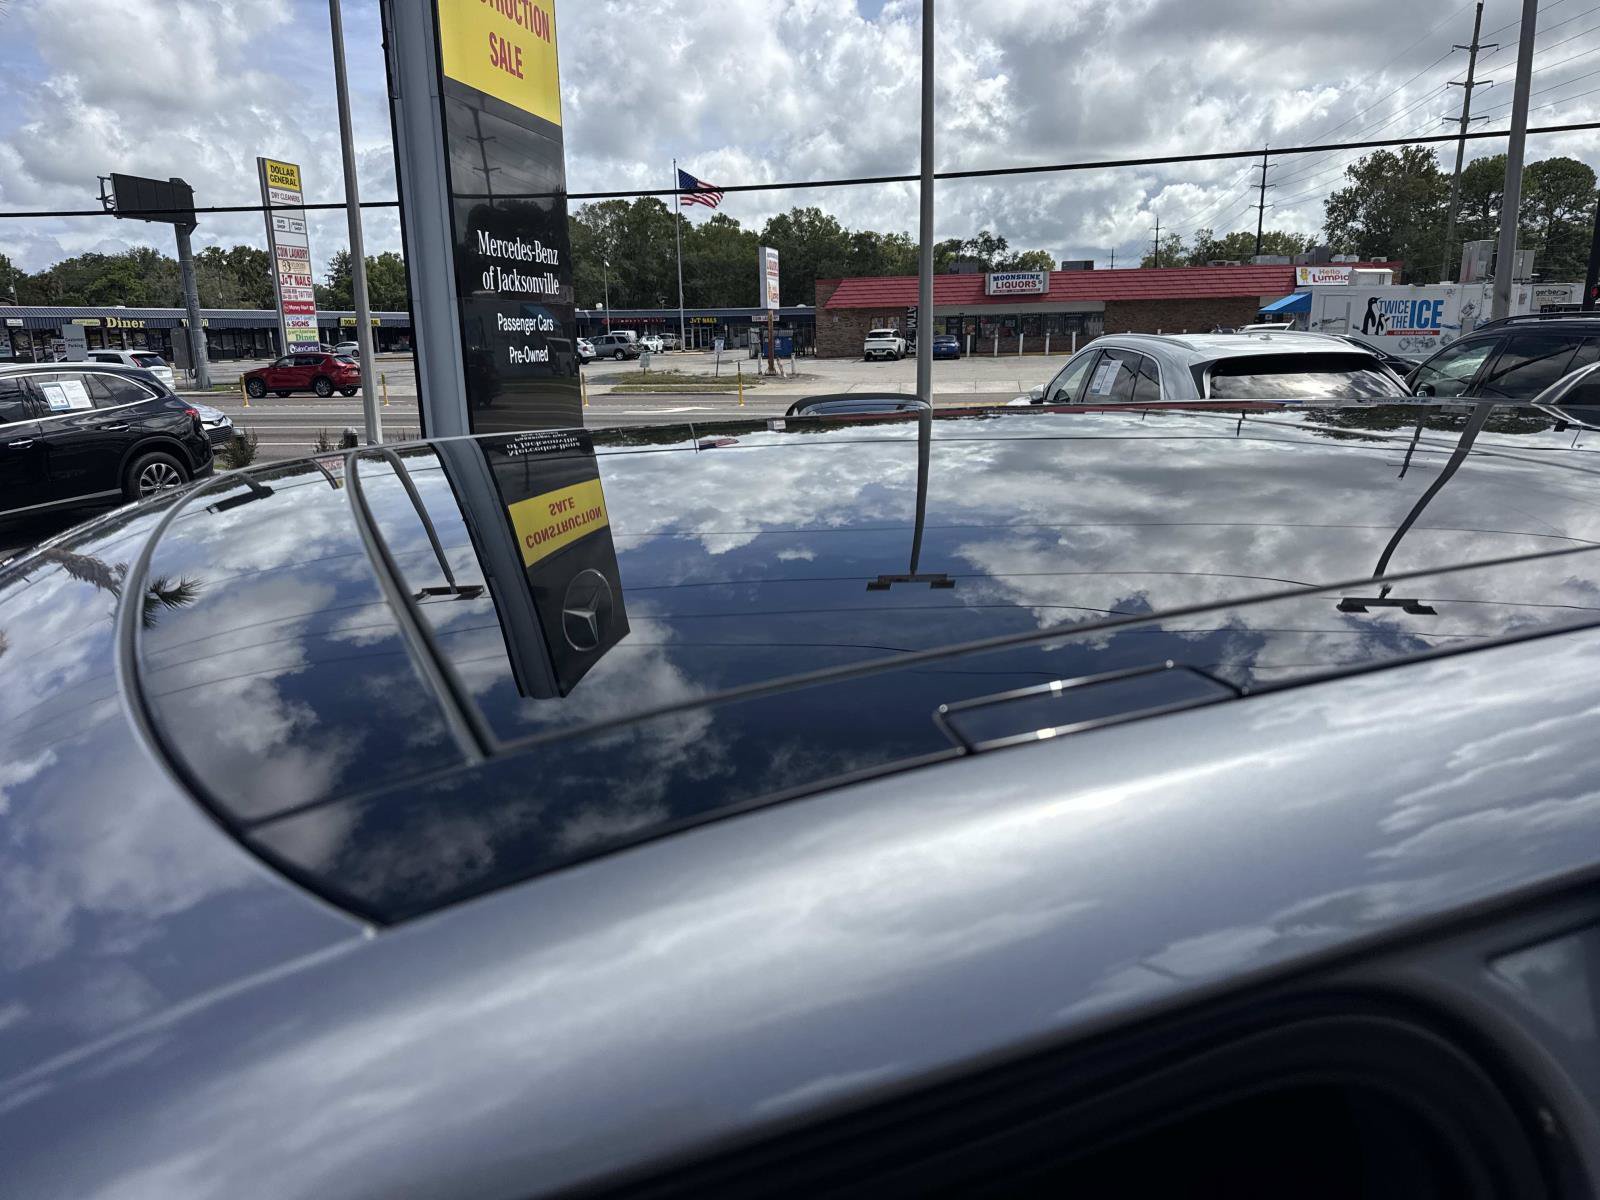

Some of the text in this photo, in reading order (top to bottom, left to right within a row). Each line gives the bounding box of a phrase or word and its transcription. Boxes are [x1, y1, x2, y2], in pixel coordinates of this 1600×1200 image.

[489, 31, 524, 80] SALE
[270, 164, 295, 178] DOLLAR
[270, 174, 298, 187] GENERAL
[271, 191, 301, 203] DRY CLEANERS
[277, 246, 308, 260] COIN LAUNDRY
[477, 229, 559, 265] Mercedes-Benz
[294, 275, 312, 287] NAILS
[482, 265, 560, 295] of Jacksonville
[996, 280, 1037, 289] LIQUORS
[1536, 289, 1560, 297] gerber
[907, 306, 917, 328] ATM
[1379, 299, 1444, 329] TWICE THE ICE
[106, 316, 146, 328] Diner
[497, 312, 554, 336] Passenger Cars
[296, 333, 316, 341] Diner
[509, 345, 549, 363] Pre-Owned
